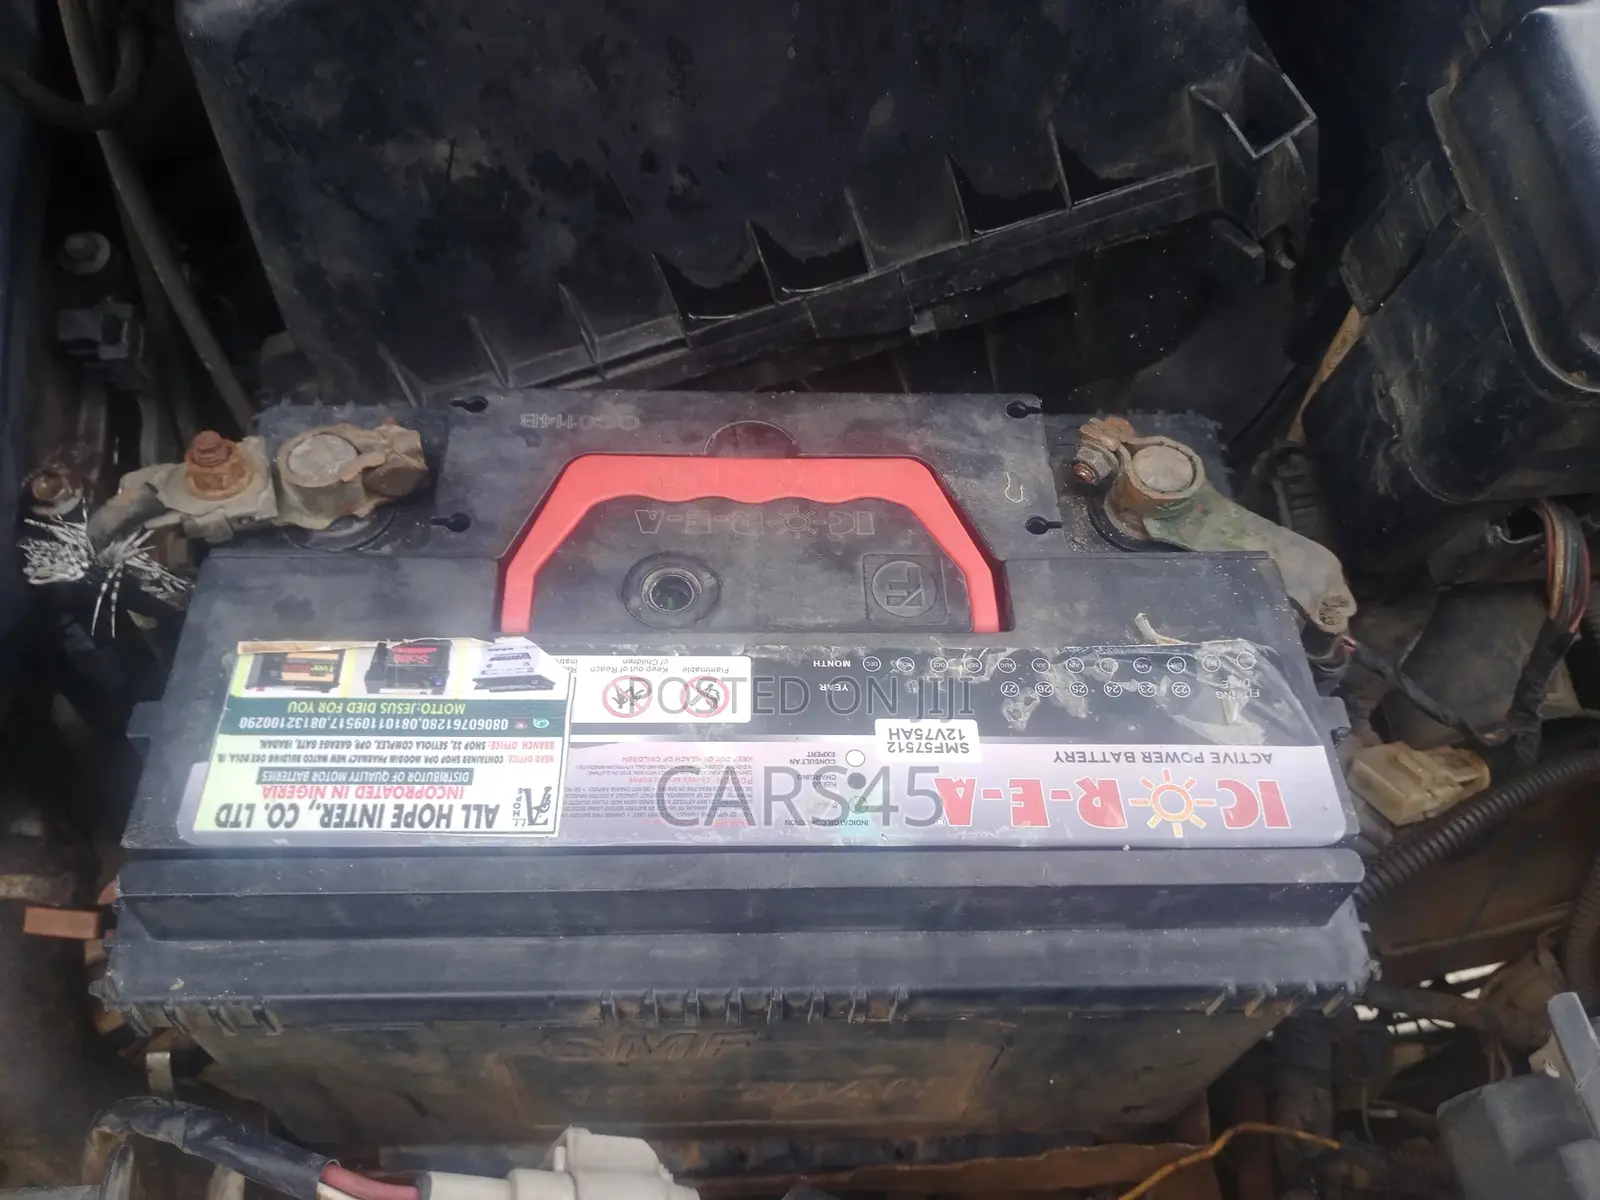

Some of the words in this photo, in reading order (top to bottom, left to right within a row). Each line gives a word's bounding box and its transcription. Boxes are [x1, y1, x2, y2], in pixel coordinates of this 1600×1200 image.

[622, 658, 658, 666] Children
[660, 658, 668, 666] of
[590, 666, 618, 674] Reach
[618, 666, 629, 674] of
[646, 664, 668, 674] Keep
[682, 666, 730, 674] Flammable
[820, 684, 848, 692] YEAR
[1216, 688, 1259, 699] FITING
[288, 702, 314, 713] YOU
[318, 702, 344, 713] FOR
[347, 702, 376, 714] DIED
[888, 728, 966, 740] 12V75AH
[295, 738, 318, 750] GATE,
[320, 739, 352, 750] GARAGE
[374, 739, 414, 750] COMPLEX,
[463, 740, 486, 750] SHOP
[488, 740, 518, 750] OFFICE:
[522, 740, 554, 750] BRANCH
[887, 742, 969, 753] SMF57512
[330, 754, 347, 763] NEW
[348, 754, 388, 763] PHARMACY
[441, 754, 461, 764] SHOP
[462, 754, 504, 764] CONTAINER
[506, 755, 533, 764] OFFICE:
[535, 755, 554, 764] HEAD
[1053, 750, 1136, 763] BATTERY
[1140, 752, 1204, 764] POWER
[1209, 752, 1272, 764] ACTIVE
[261, 770, 310, 781] BATTERIES
[312, 770, 346, 781] MOTOR
[348, 770, 390, 782] QUALITY
[392, 771, 406, 782] OF
[408, 771, 470, 782] DISTRIBUTOR
[262, 784, 326, 799] NIGERIA
[330, 785, 349, 799] IN
[354, 785, 464, 800] INCOPROATED
[214, 803, 256, 828] LTD
[264, 803, 300, 828] CO.
[308, 800, 385, 828] INTER.,
[390, 803, 454, 828] HOPE
[461, 804, 500, 828] ALL
